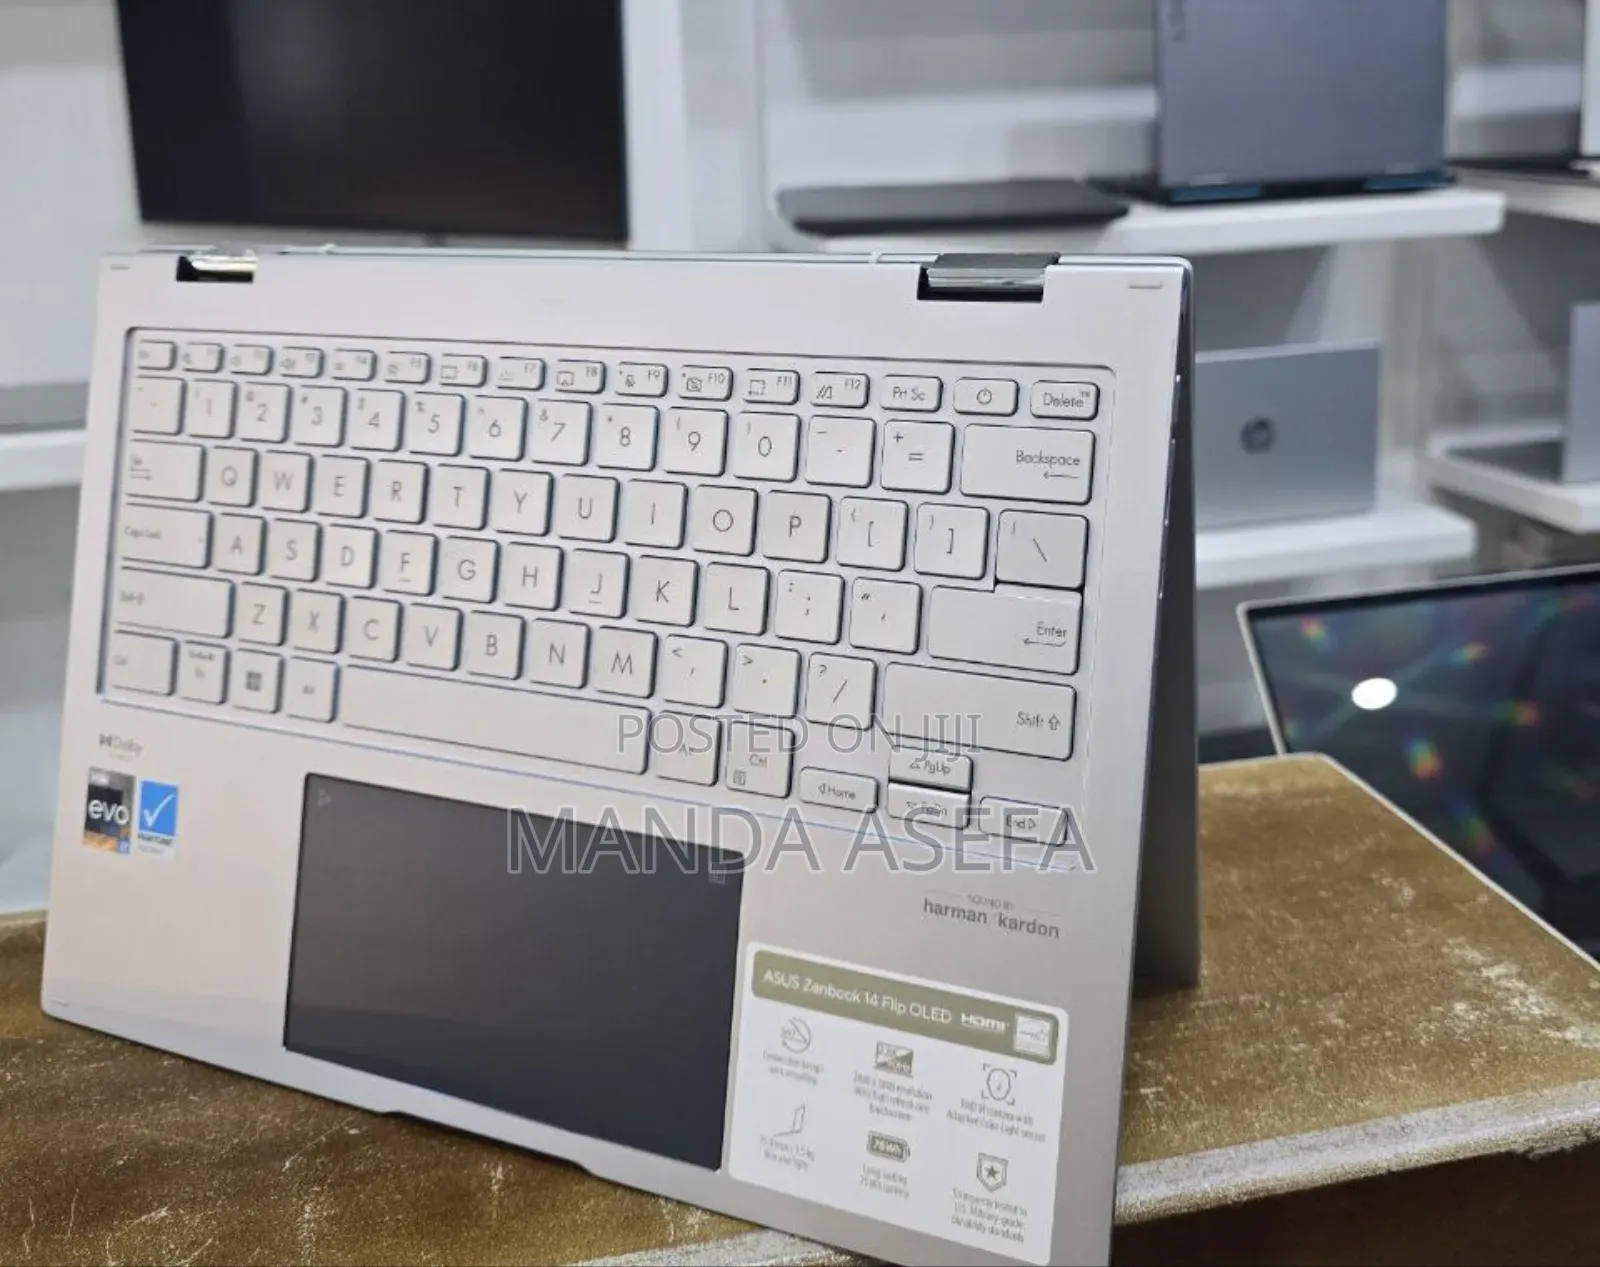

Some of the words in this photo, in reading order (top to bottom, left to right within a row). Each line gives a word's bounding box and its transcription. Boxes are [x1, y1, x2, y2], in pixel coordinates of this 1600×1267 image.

[586, 366, 598, 377] F8
[648, 369, 660, 380] F9
[707, 372, 726, 385] F10
[776, 376, 793, 387] F11
[844, 379, 861, 390] F12
[911, 388, 925, 401] Sc
[1042, 392, 1084, 408] Delete
[256, 403, 269, 423] 2
[311, 406, 323, 426] 3
[367, 410, 381, 430] 4
[428, 414, 441, 434] 5
[488, 419, 501, 438] 6
[551, 422, 566, 442] 7
[619, 426, 631, 447] 8
[687, 431, 701, 451] 9
[1015, 449, 1081, 468] Backspace
[220, 466, 238, 487] Q
[273, 470, 294, 491] W
[333, 475, 345, 497] E
[390, 481, 402, 501] R
[452, 486, 466, 507] T
[513, 491, 527, 513] Y
[578, 497, 592, 520] U
[789, 515, 802, 538] P
[230, 535, 243, 554] A
[285, 539, 298, 561] S
[340, 545, 355, 567] D
[399, 552, 412, 573] F
[458, 559, 477, 581] G
[522, 565, 538, 588] H
[590, 573, 602, 595] J
[656, 580, 670, 603] K
[728, 586, 740, 611] L
[252, 603, 266, 625] Z
[307, 610, 320, 632] X
[362, 618, 380, 641] C
[423, 625, 440, 647] V
[1036, 621, 1068, 638] Enter
[486, 634, 498, 656] B
[549, 643, 566, 665] N
[610, 651, 633, 675] M
[1016, 711, 1045, 729] Shift
[922, 759, 951, 775] PgUp
[827, 786, 856, 800] Home
[87, 798, 130, 825] evo
[1005, 814, 1027, 830] End
[967, 893, 998, 908] SOUND
[923, 897, 988, 924] harman
[997, 912, 1060, 938] kardon
[763, 968, 800, 990] ASUS
[802, 978, 861, 1004] Zenbook
[864, 991, 878, 1007] 14
[882, 996, 906, 1017] Flip
[909, 1002, 953, 1024] OLED
